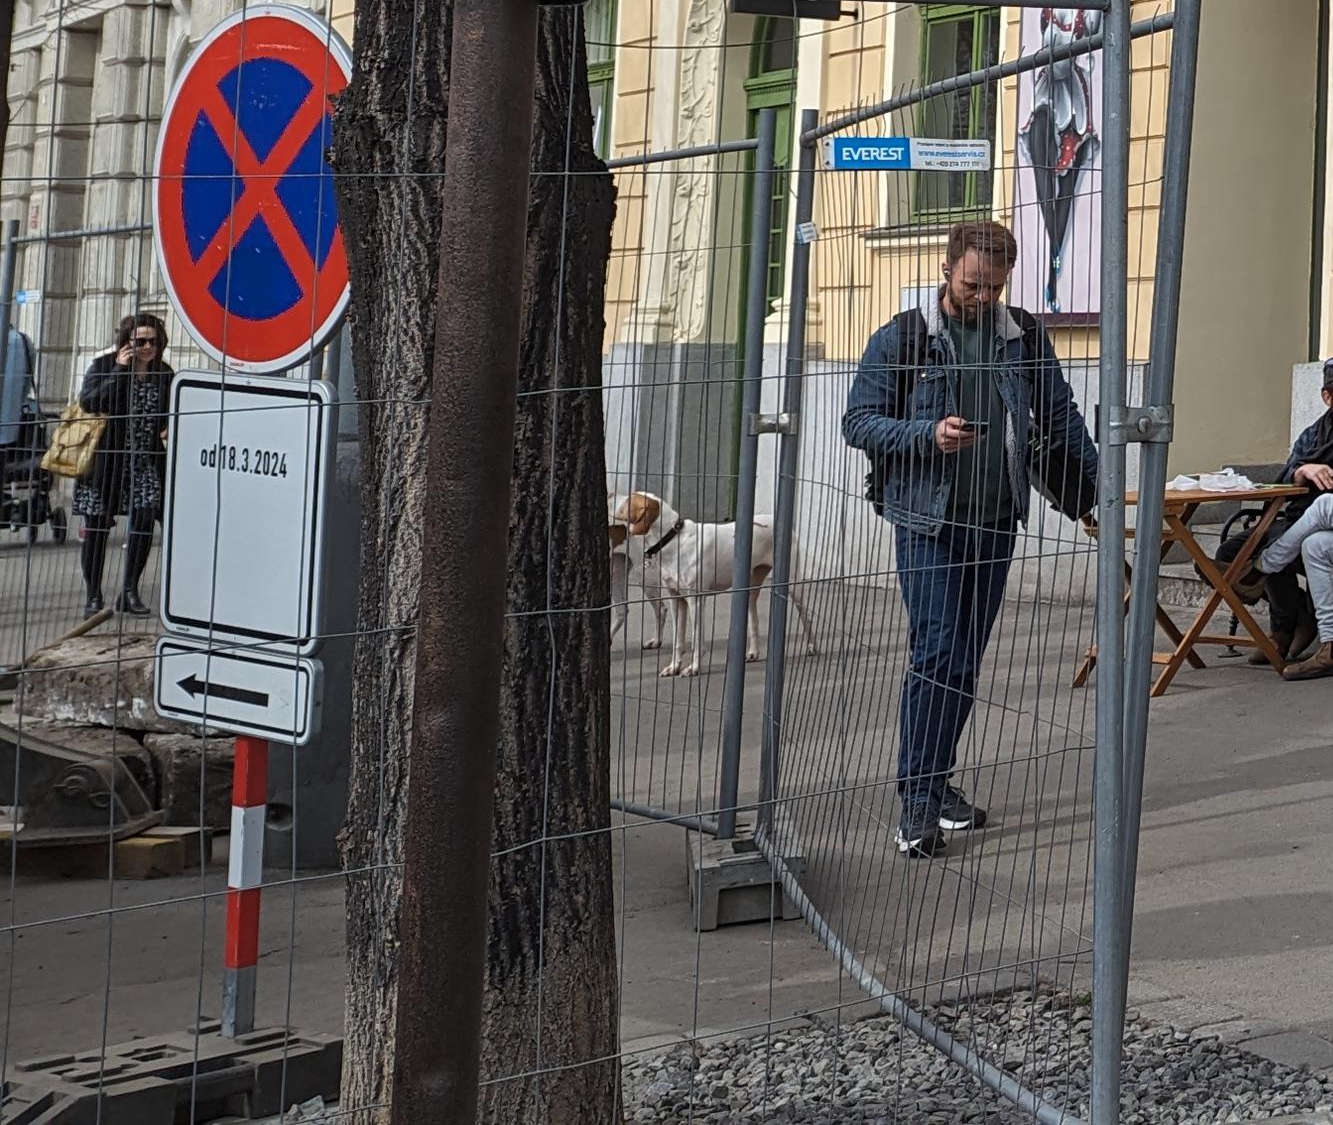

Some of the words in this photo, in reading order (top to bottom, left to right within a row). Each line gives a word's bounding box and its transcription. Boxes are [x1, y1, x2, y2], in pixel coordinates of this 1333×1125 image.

[842, 147, 904, 161] EVEREST
[200, 443, 217, 468] od
[219, 444, 288, 479] 18.3.2024
